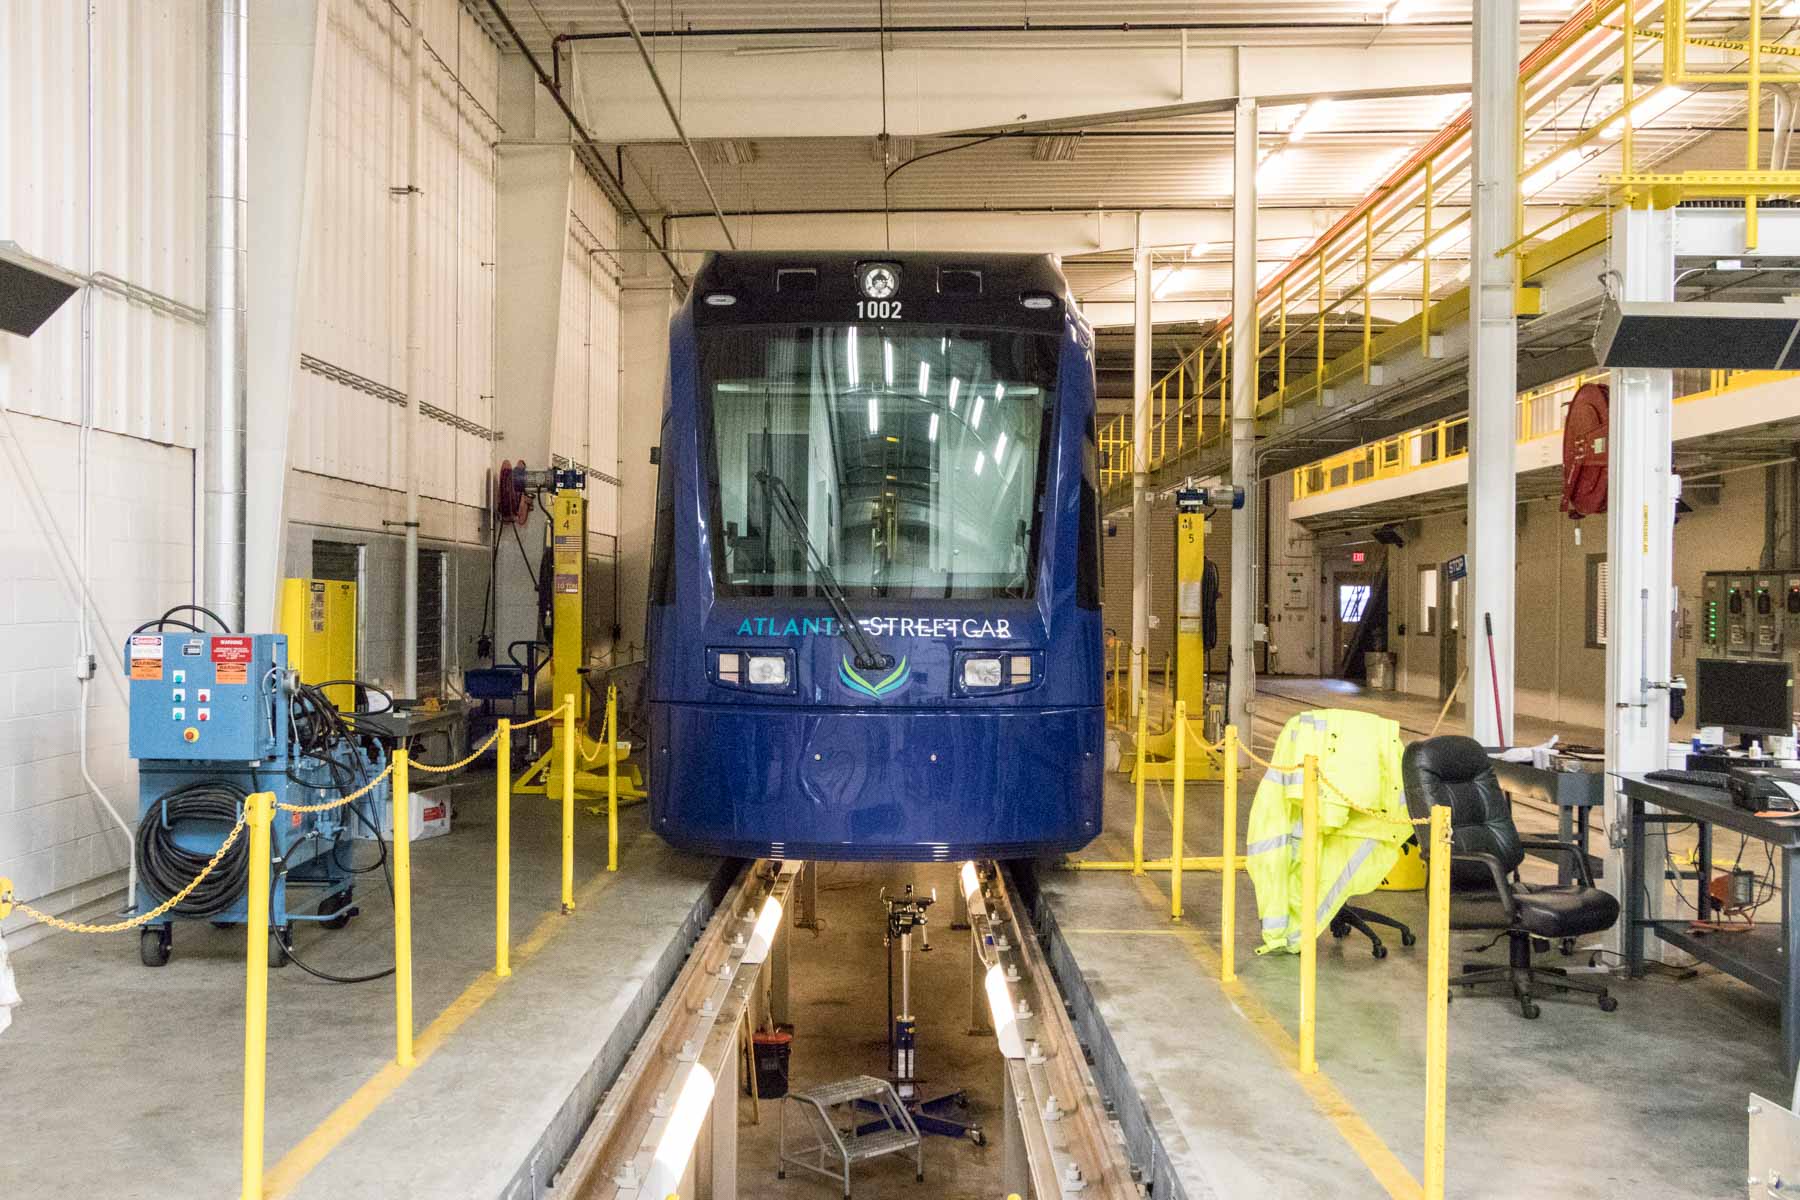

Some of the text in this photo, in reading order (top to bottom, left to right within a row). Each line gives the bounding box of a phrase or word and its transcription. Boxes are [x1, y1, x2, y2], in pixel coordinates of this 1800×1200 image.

[856, 300, 902, 319] 1002
[563, 519, 569, 531] 4
[1188, 533, 1194, 544] 5
[1353, 552, 1365, 562] EXIT
[737, 616, 1012, 638] ATLANT STREETCAR
